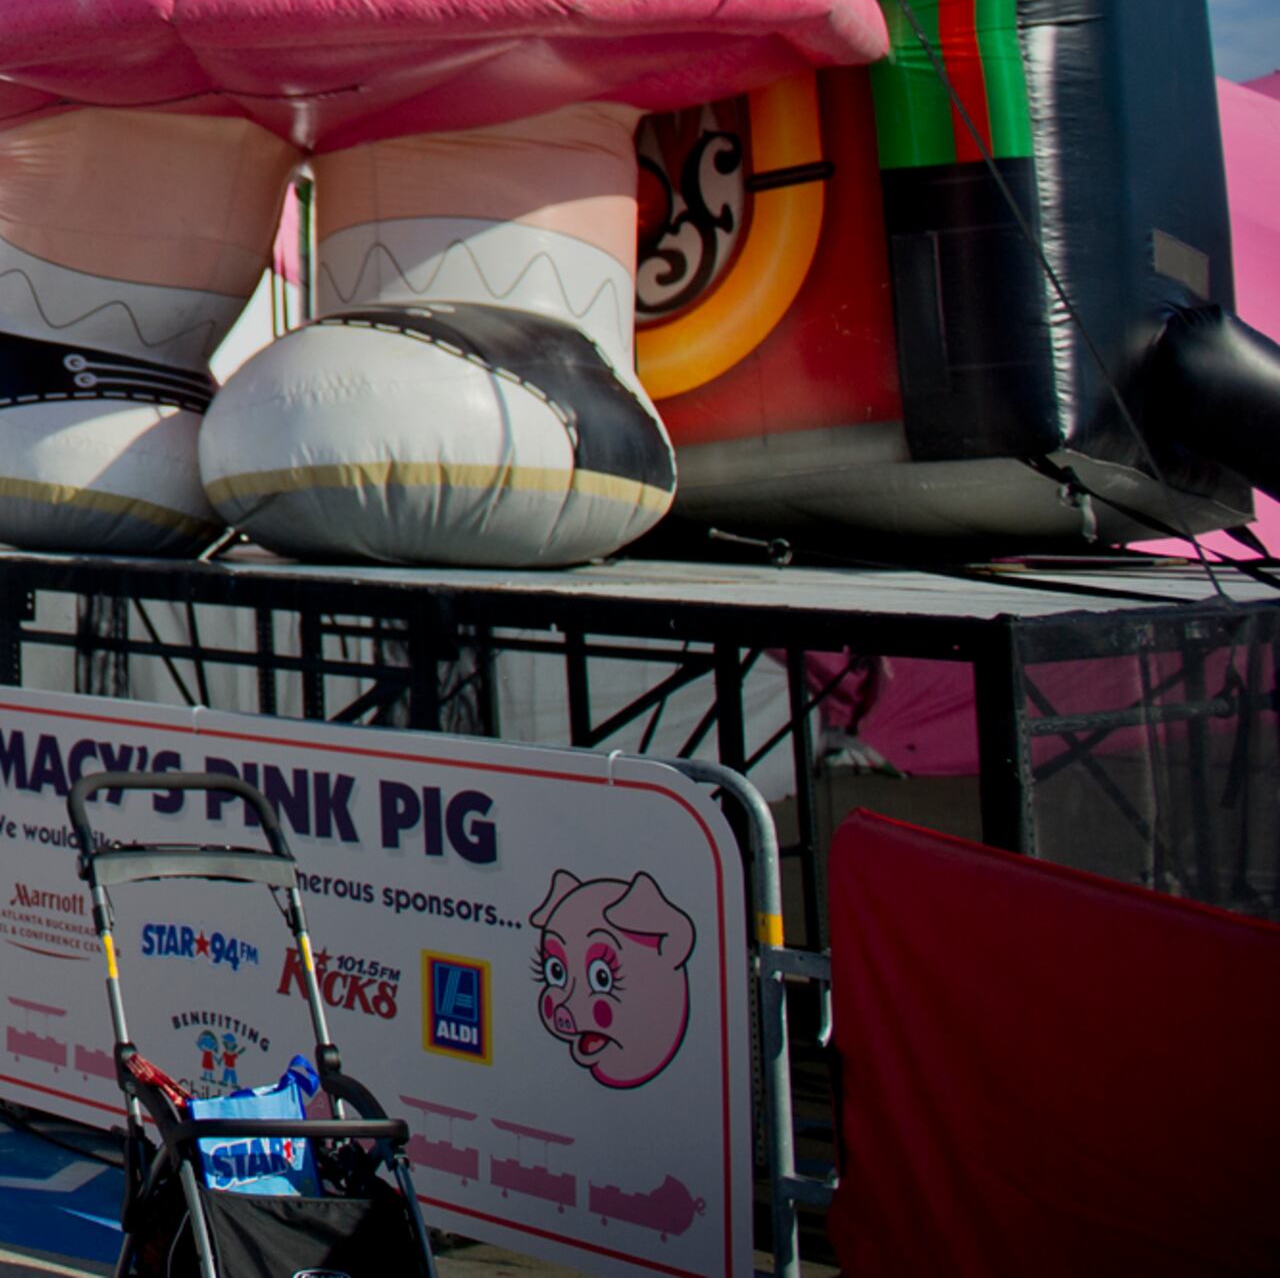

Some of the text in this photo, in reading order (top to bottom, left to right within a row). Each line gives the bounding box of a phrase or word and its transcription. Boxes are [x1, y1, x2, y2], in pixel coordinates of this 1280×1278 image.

[204, 756, 360, 843] PINK
[378, 778, 498, 865] PIG
[10, 882, 85, 916] Marriott
[272, 870, 523, 929] nerous sponsors...
[1, 909, 43, 926] ATLANTA
[19, 927, 81, 950] CONFERENCE
[142, 923, 195, 958] STAR
[171, 1011, 270, 1053] BENEFITTING
[436, 1020, 479, 1046] ALDI
